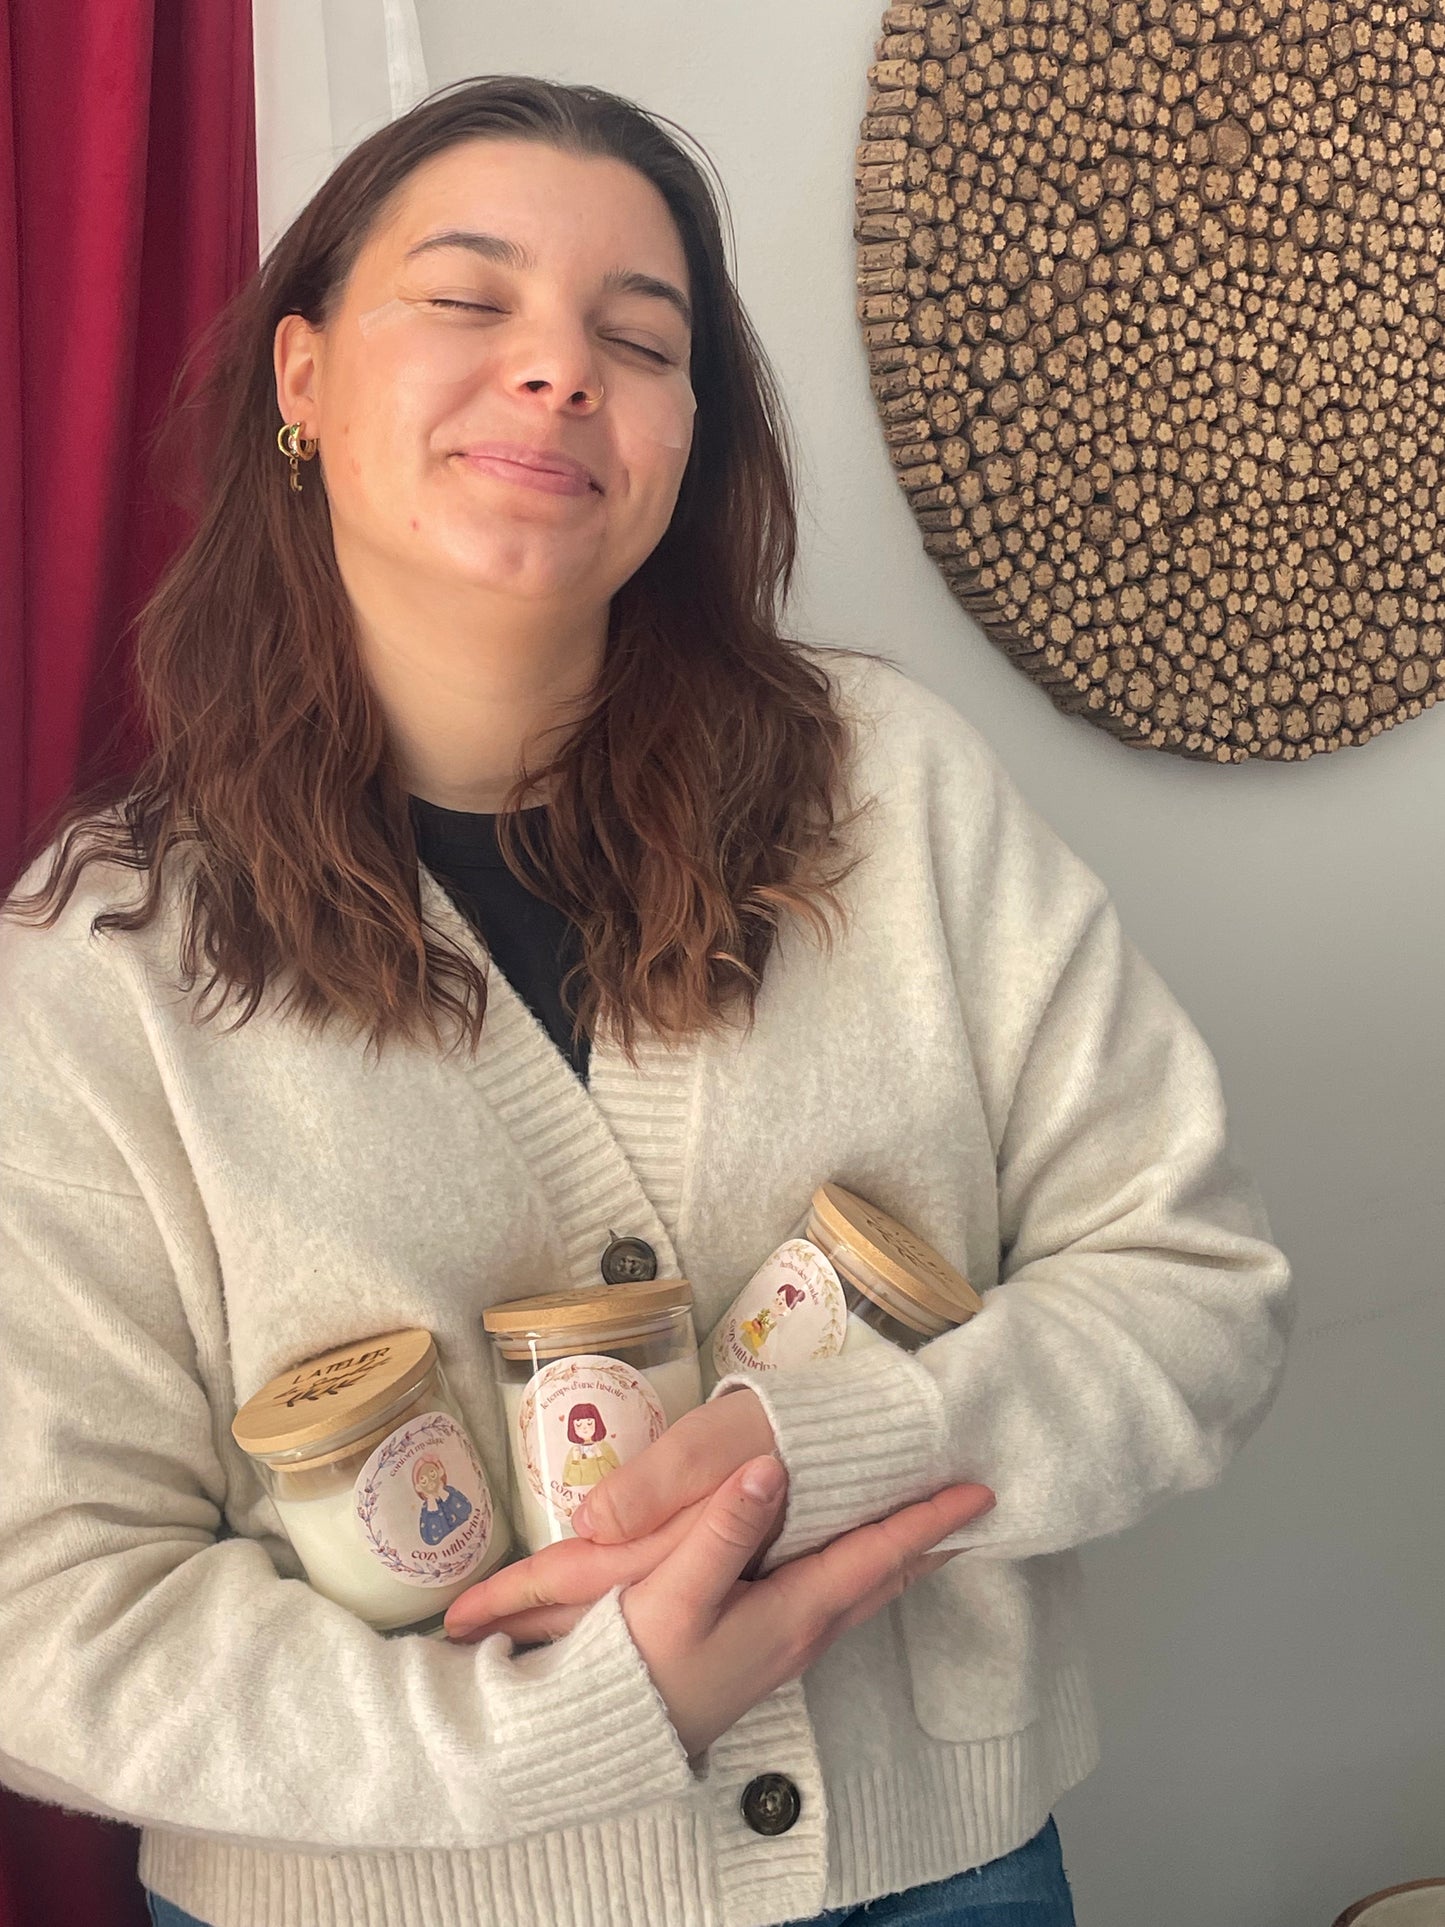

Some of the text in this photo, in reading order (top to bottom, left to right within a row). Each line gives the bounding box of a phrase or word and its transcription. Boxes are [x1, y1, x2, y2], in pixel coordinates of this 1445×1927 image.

[595, 1380, 628, 1401] histoire
[411, 1508, 481, 1564] cozy with brina
